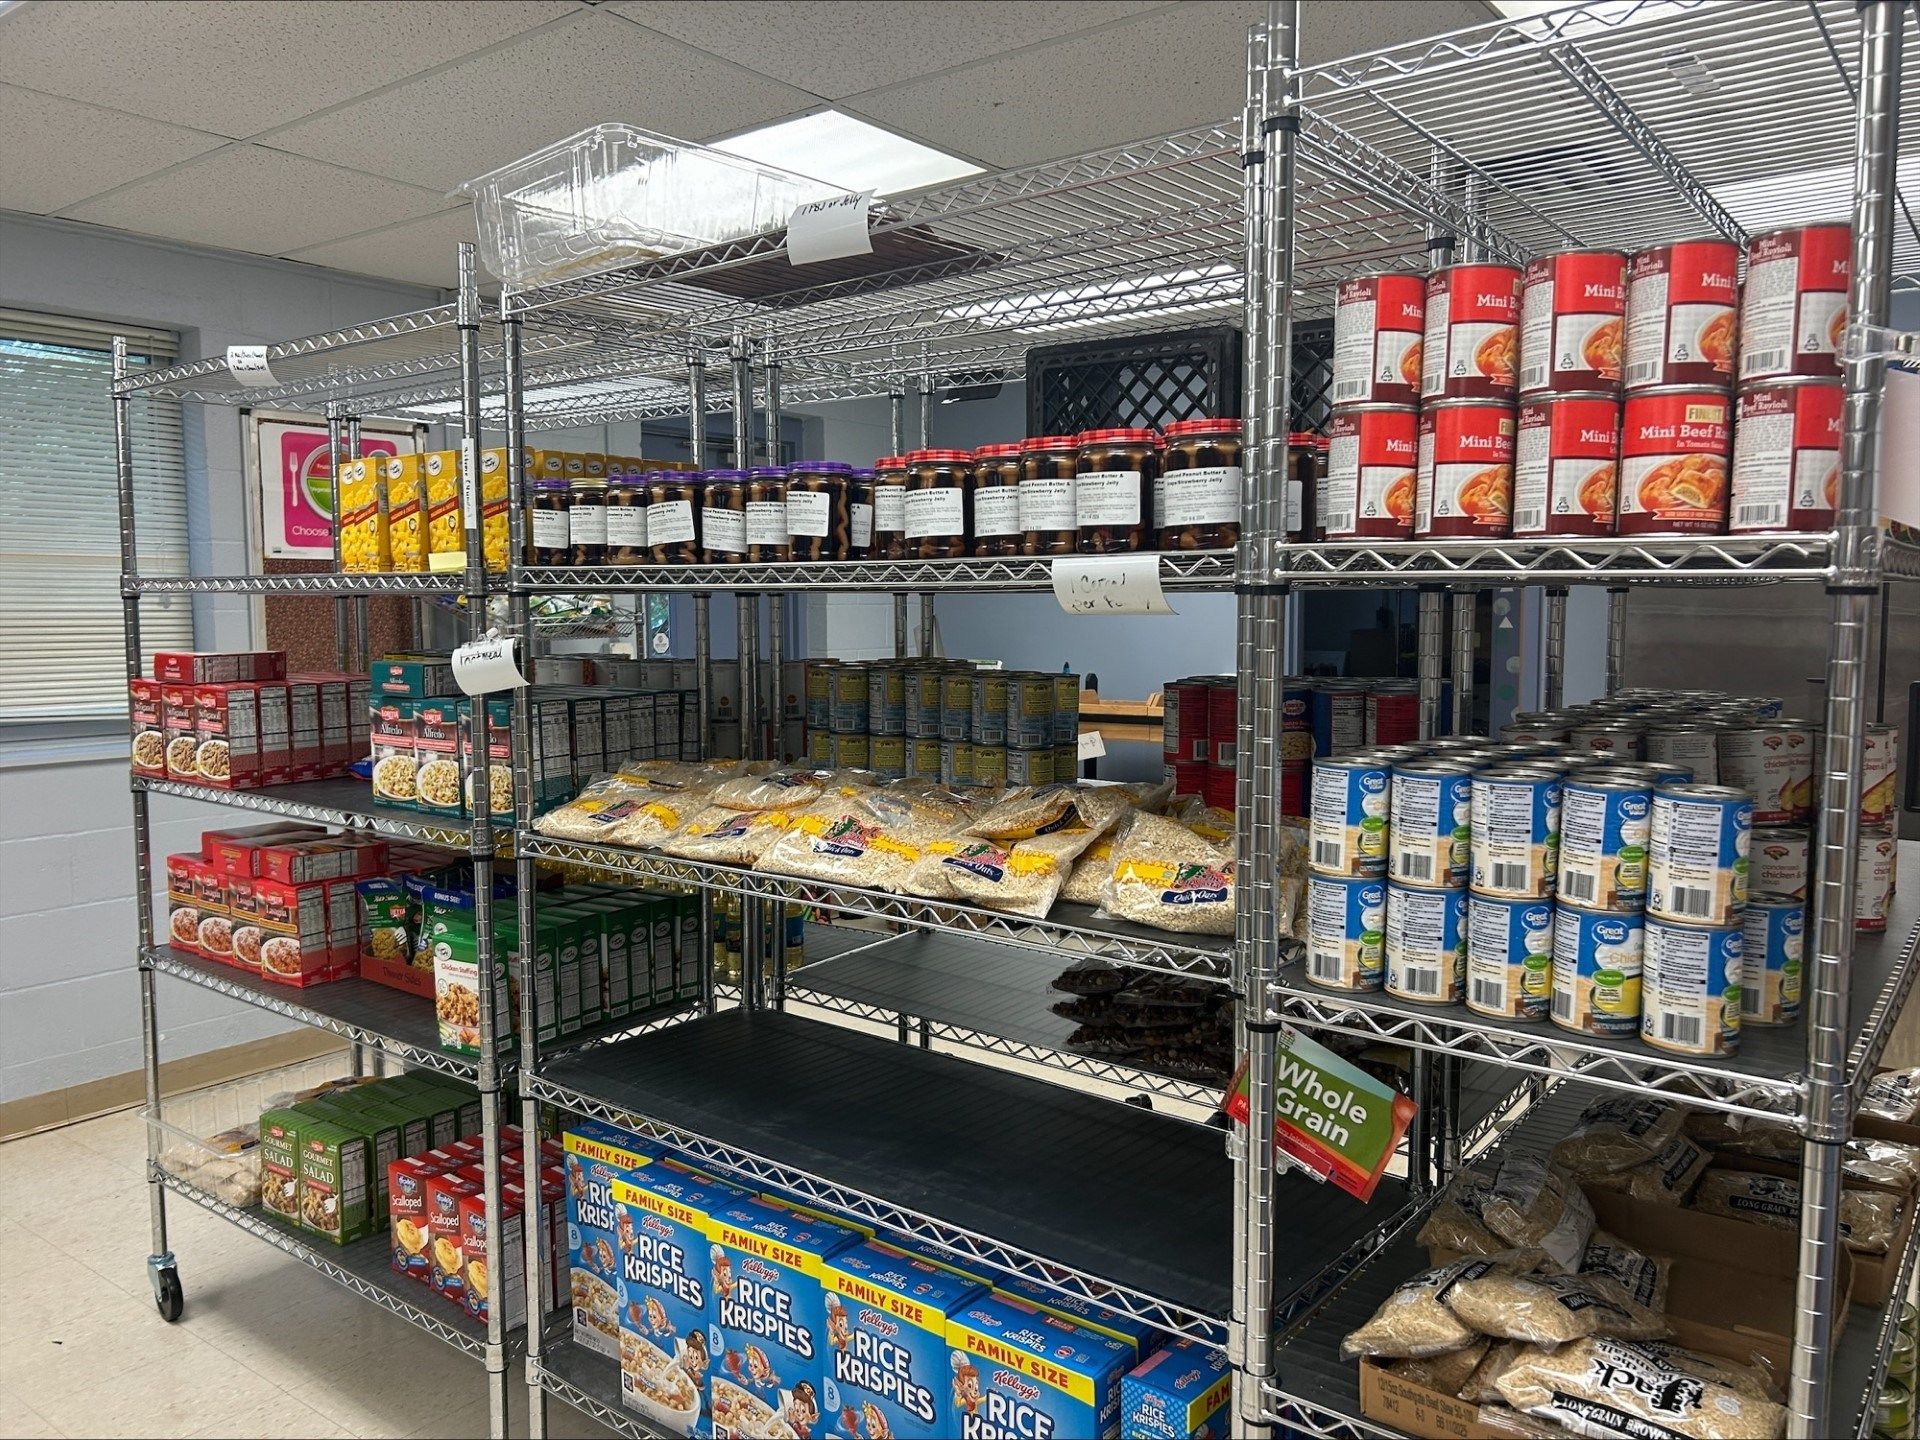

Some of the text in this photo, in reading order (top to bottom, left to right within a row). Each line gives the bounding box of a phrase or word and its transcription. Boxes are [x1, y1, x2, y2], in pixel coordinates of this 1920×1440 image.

[1759, 239, 1776, 249] Mini
[1702, 273, 1731, 288] Mini
[1349, 289, 1372, 298] Ravioli
[1584, 284, 1615, 298] Mini
[1477, 294, 1507, 308] Mini
[1753, 393, 1771, 402] Mini
[1758, 399, 1788, 410] Ravioli
[1580, 429, 1610, 444] Mini
[1640, 424, 1713, 439] Mini Beef
[1386, 439, 1412, 453] Mini
[1460, 435, 1492, 448] Mini
[292, 525, 329, 536] Choose
[381, 724, 402, 735] Alfredo
[424, 729, 445, 739] Alfredo
[1364, 777, 1384, 786] Great
[1623, 802, 1646, 811] Great
[974, 861, 994, 876] Oats
[434, 893, 449, 902] BONUS
[1362, 891, 1381, 899] Great
[1525, 912, 1548, 921] Great
[1597, 927, 1624, 937] Great
[459, 967, 477, 976] Stuffing
[1278, 1055, 1368, 1124] Whole
[1276, 1087, 1349, 1147] Grain
[264, 1135, 292, 1152] GOURMET
[264, 1149, 293, 1168] SALAD
[303, 1150, 333, 1167] GOURMET
[575, 1141, 637, 1169] FAMILY SIZE
[303, 1163, 334, 1184] SALAD
[392, 1194, 422, 1212] Scalloped
[589, 1182, 613, 1210] RIC
[625, 1189, 693, 1224] FAMILY SIZE
[430, 1212, 459, 1228] Scalloped
[642, 1215, 675, 1237] Kellogg's
[769, 1222, 789, 1232] RICE
[571, 1230, 577, 1239] 8
[751, 1224, 788, 1239] KRISPIES
[639, 1235, 683, 1273] RICE
[722, 1230, 802, 1268] FAMILY SIZE
[742, 1258, 779, 1282] Kellogg's
[885, 1271, 907, 1283] RICE
[624, 1256, 701, 1307] KRISPIES
[868, 1273, 906, 1290] KRISPIES
[738, 1278, 790, 1320] RICE
[838, 1277, 923, 1323] FAMILY SIZE
[720, 1299, 812, 1357] KRISPIES
[859, 1309, 898, 1335] Kellogg's
[713, 1333, 719, 1345] 8
[1002, 1330, 1047, 1354] KRISPIES
[1019, 1328, 1045, 1343] RICE
[856, 1330, 909, 1378] RICE
[966, 1334, 1069, 1389] FAMILY SIZE
[828, 1387, 834, 1400] 8
[836, 1352, 934, 1421] KRISPIES
[992, 1370, 1041, 1400] Kellogg's
[1591, 1358, 1703, 1415] Jack
[1206, 1381, 1230, 1411] FAM
[988, 1391, 1052, 1437] RICE
[1142, 1404, 1165, 1422] RICE
[1591, 1407, 1624, 1427] GRAIN
[1133, 1412, 1174, 1438] KRISPIES
